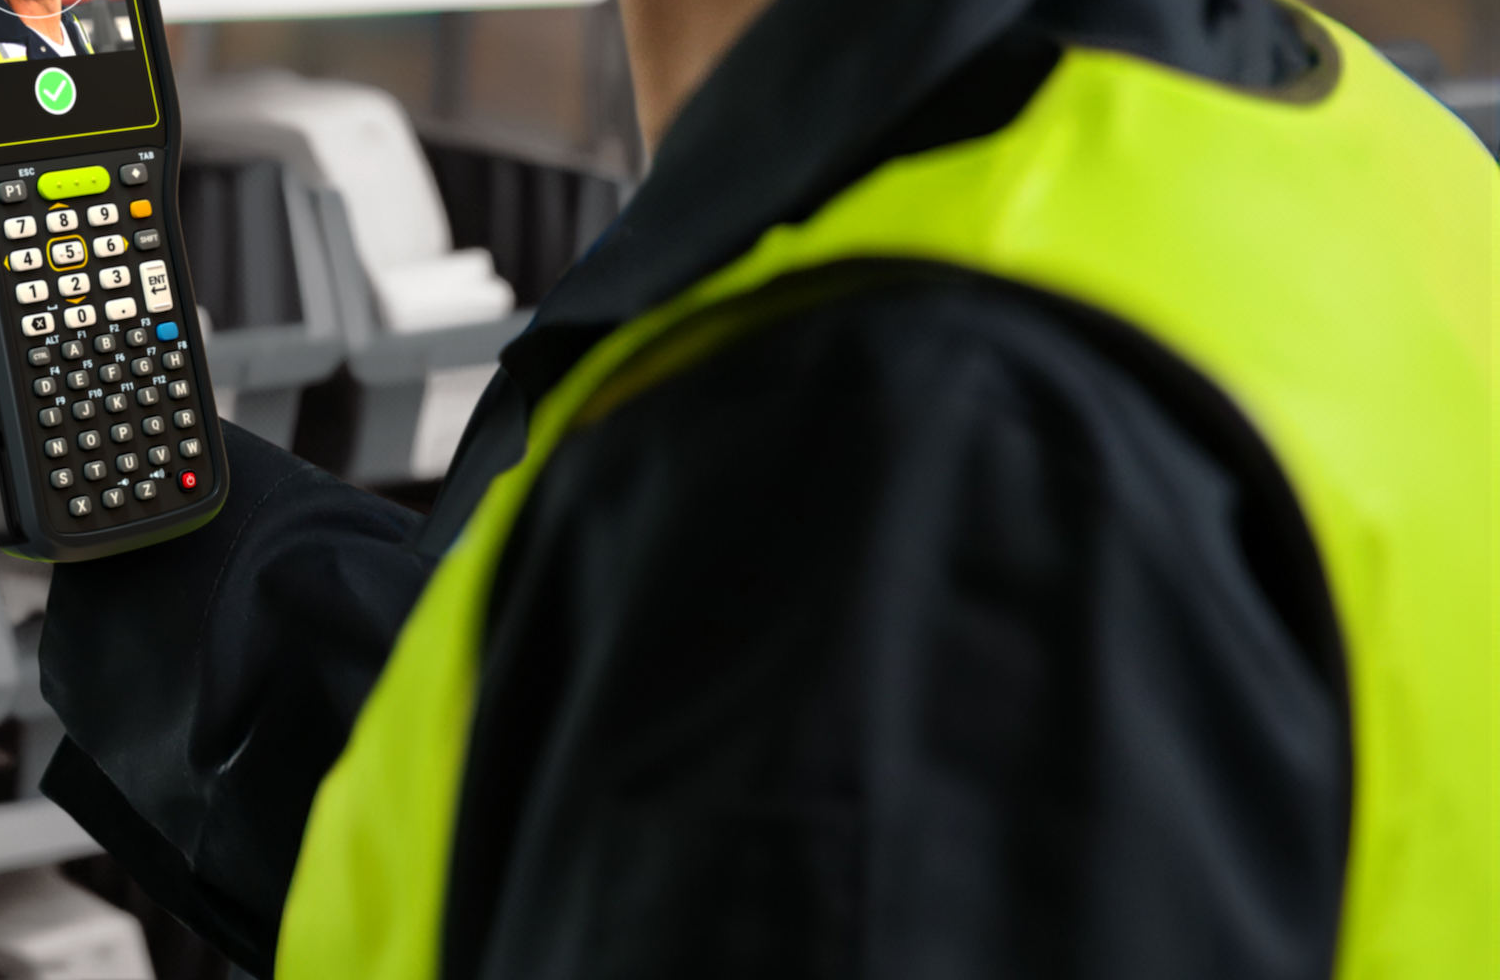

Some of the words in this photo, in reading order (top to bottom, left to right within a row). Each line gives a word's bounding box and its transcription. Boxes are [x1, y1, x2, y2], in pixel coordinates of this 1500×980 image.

[138, 151, 155, 161] TAB
[18, 167, 35, 178] ESC
[5, 184, 22, 197] P1
[59, 213, 69, 227] 8
[100, 207, 110, 221] 9
[16, 219, 26, 234] 7
[139, 233, 158, 244] SHIFT
[106, 238, 116, 252] 6
[65, 245, 75, 259] 5
[23, 251, 33, 266] 4
[112, 270, 122, 284] 3
[148, 274, 166, 286] ENT
[71, 277, 81, 291] 2
[28, 284, 37, 299] 1
[77, 309, 87, 323] 0
[109, 324, 120, 333] F2
[141, 318, 151, 327] F3
[45, 334, 60, 346] ALT
[77, 330, 87, 339] F1
[134, 332, 144, 343] C
[70, 344, 80, 355] A
[102, 338, 111, 349] B
[177, 341, 188, 350] F8
[33, 352, 48, 360] CTRL
[115, 353, 126, 362] F6
[146, 347, 156, 356] F7
[82, 359, 93, 369] F5
[171, 354, 181, 366] H
[50, 366, 60, 376] F4
[140, 361, 149, 372] G
[108, 367, 116, 379] F
[41, 380, 51, 392] D
[75, 374, 84, 386] E
[152, 375, 166, 385] F12
[120, 382, 134, 391] F11
[175, 384, 187, 395] M
[88, 388, 103, 399] F10
[146, 391, 155, 402] L
[55, 396, 66, 406] F9
[113, 397, 123, 409] K
[82, 403, 90, 415] J
[50, 411, 55, 423] I
[183, 413, 192, 425] R
[151, 420, 160, 431] Q
[119, 427, 128, 439] P
[86, 434, 95, 446] O
[53, 441, 63, 453] N
[187, 442, 198, 454] W
[156, 449, 165, 461] V
[125, 456, 134, 469] U
[92, 464, 101, 476] T
[59, 472, 68, 484] S
[143, 484, 152, 496] Z
[110, 492, 119, 504] Y
[77, 500, 87, 513] X
